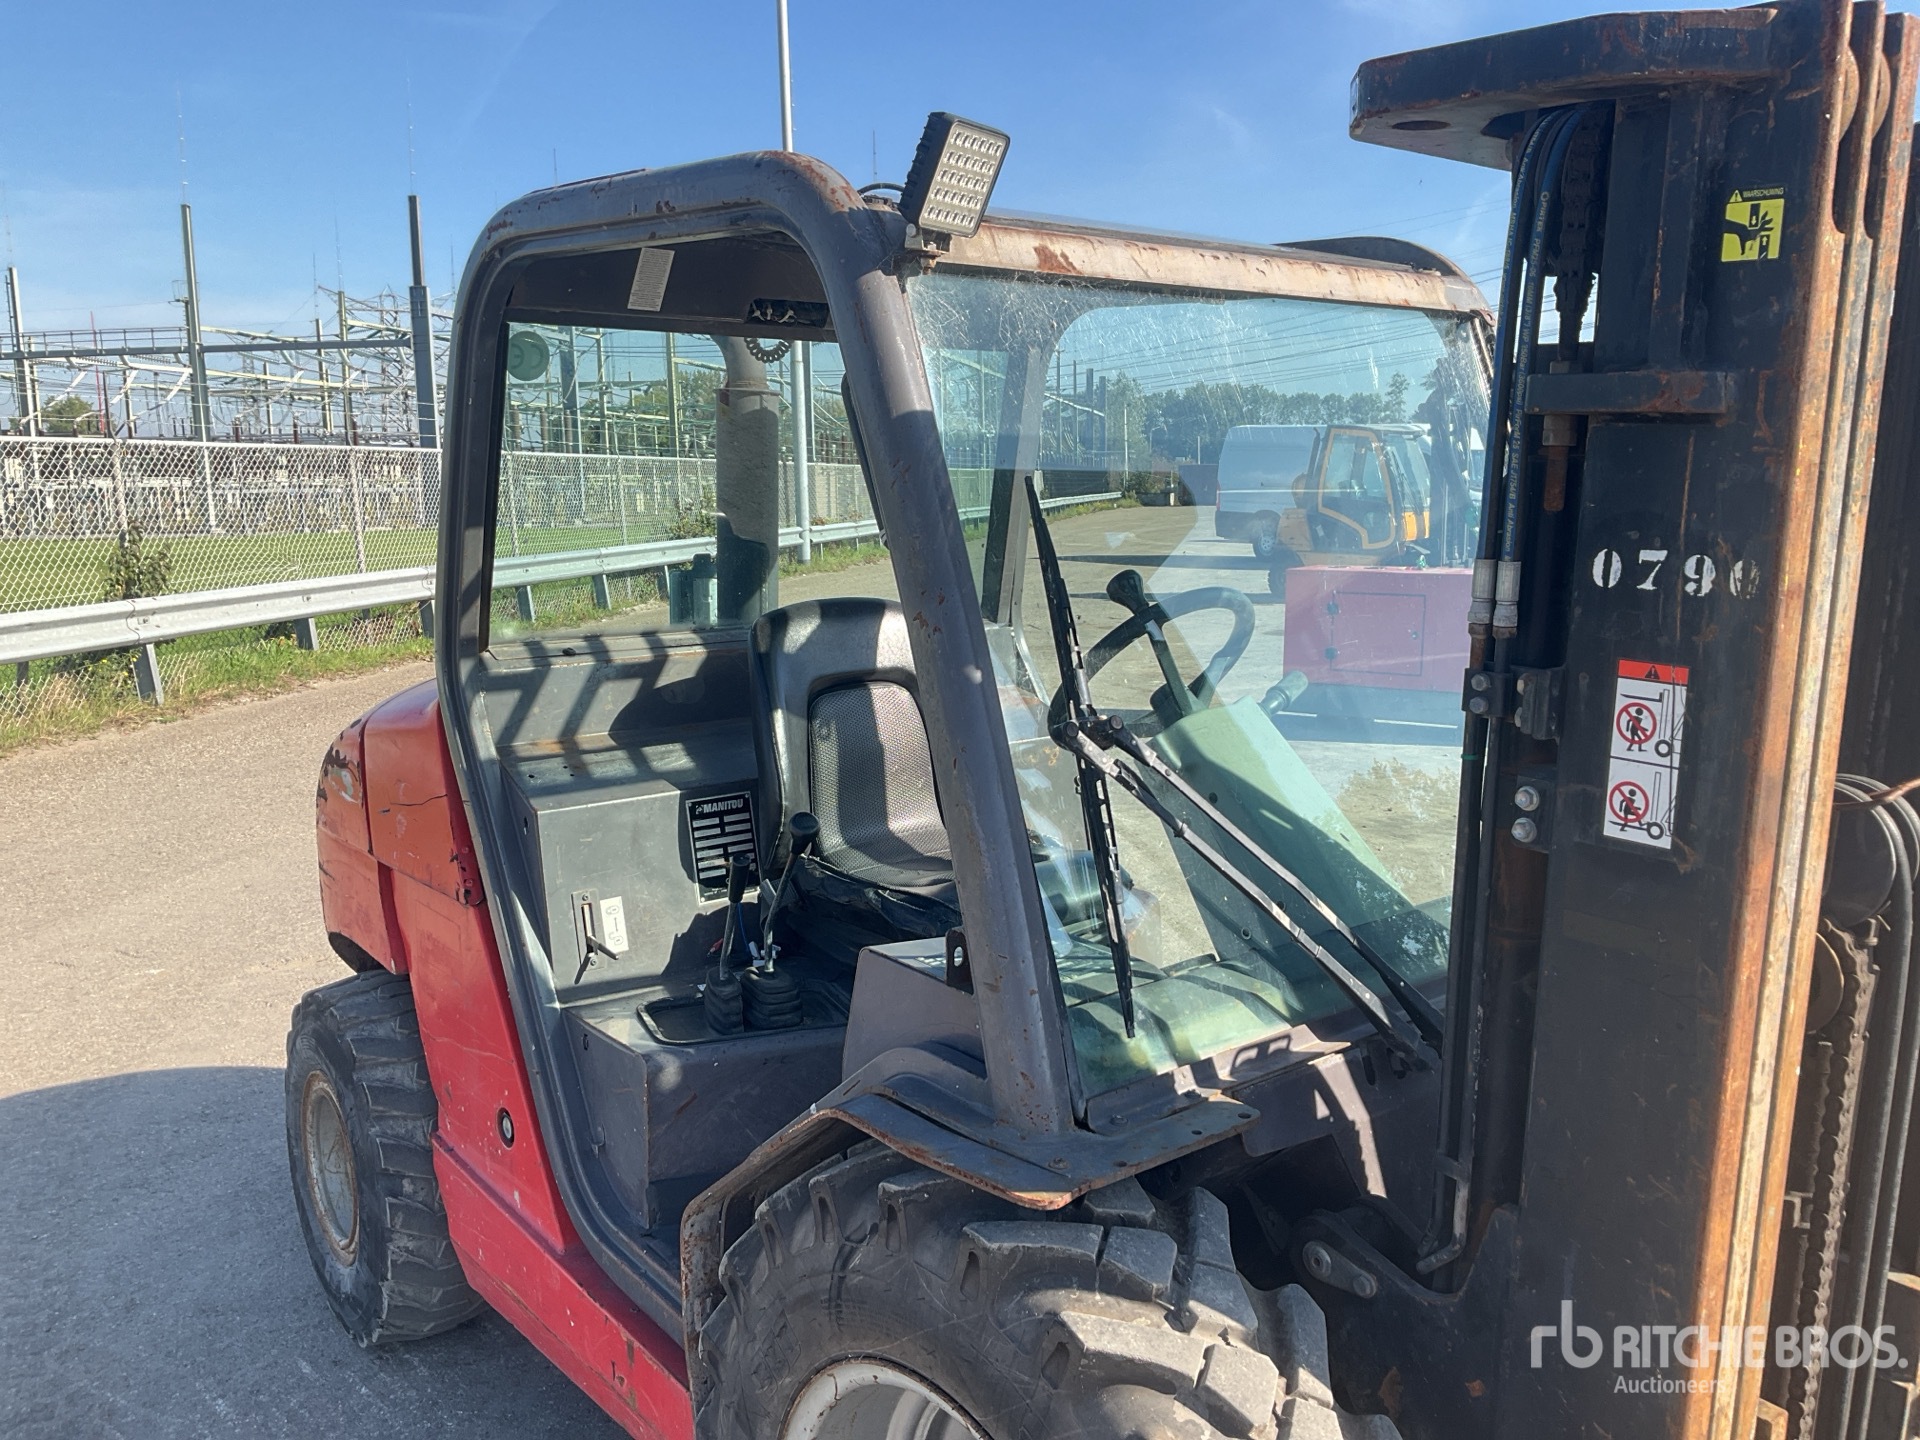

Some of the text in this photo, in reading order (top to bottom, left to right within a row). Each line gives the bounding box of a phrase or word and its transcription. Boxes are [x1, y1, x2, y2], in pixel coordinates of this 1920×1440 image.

[1743, 187, 1784, 198] WAARSCHUWING
[1536, 201, 1548, 232] PIRTEK
[1512, 440, 1521, 450] 25
[1510, 452, 1520, 469] SAE
[1508, 469, 1519, 500] J1754/B
[1507, 502, 1516, 518] Anti
[1505, 518, 1514, 552] Abrasion
[703, 798, 744, 813] MANITOU
